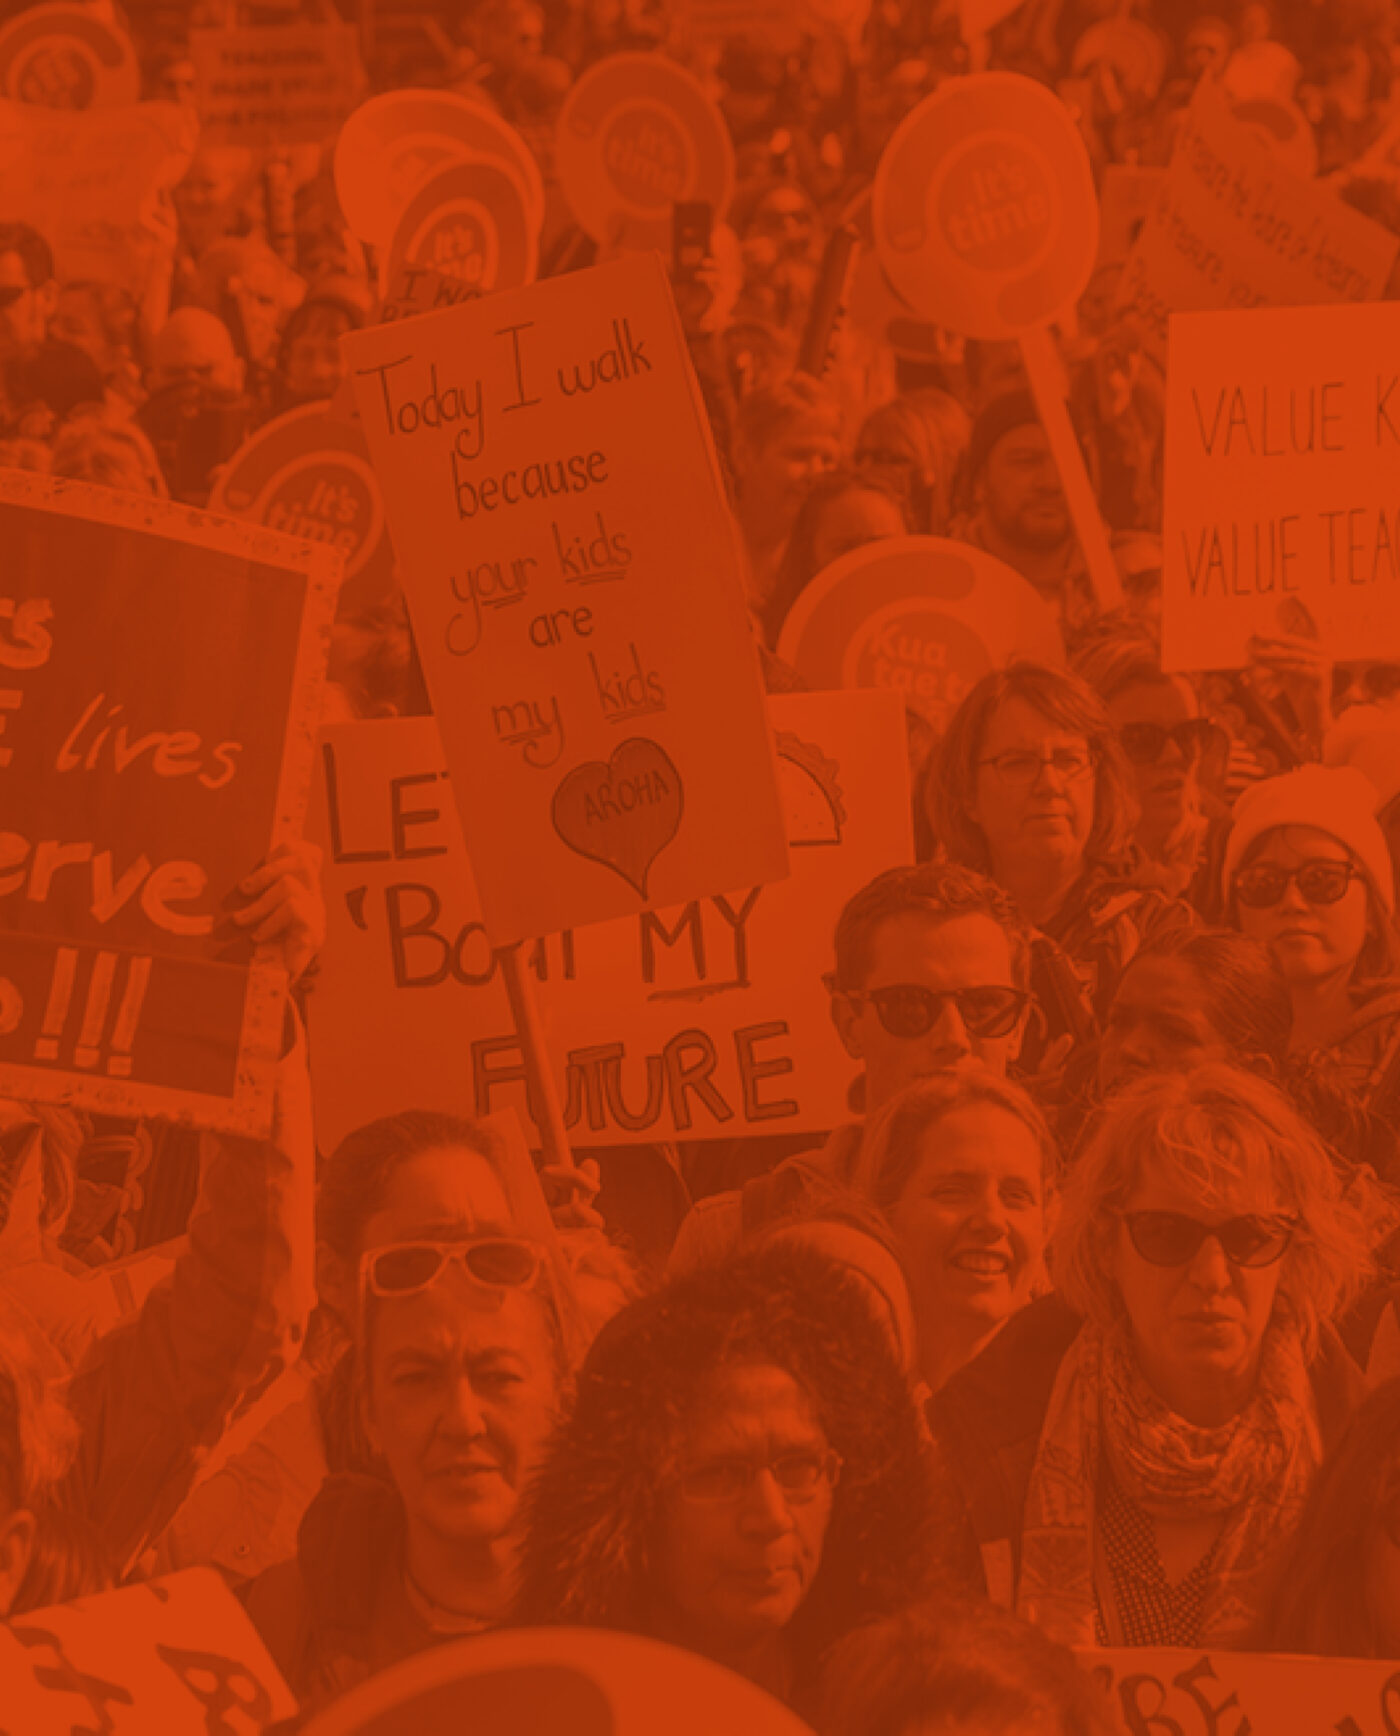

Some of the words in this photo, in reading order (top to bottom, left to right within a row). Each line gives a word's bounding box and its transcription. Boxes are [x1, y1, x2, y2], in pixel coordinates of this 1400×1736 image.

[969, 159, 1027, 206] It's
[948, 192, 1052, 252] time
[355, 354, 485, 461] Today
[493, 321, 543, 413] I
[557, 317, 654, 396] walk
[1191, 380, 1345, 456] VALUE
[307, 478, 359, 523] It's
[450, 449, 609, 521] because
[446, 556, 539, 657] your
[551, 510, 634, 575] kids
[1180, 513, 1301, 597] VALUE
[1318, 506, 1400, 586] TEA
[528, 605, 596, 648] are
[871, 622, 950, 671] Kua
[56, 691, 244, 789] lives
[491, 695, 567, 770] my
[586, 641, 667, 708] kids
[322, 741, 450, 864] LE
[583, 768, 671, 826] AROHA
[640, 886, 764, 984] MY
